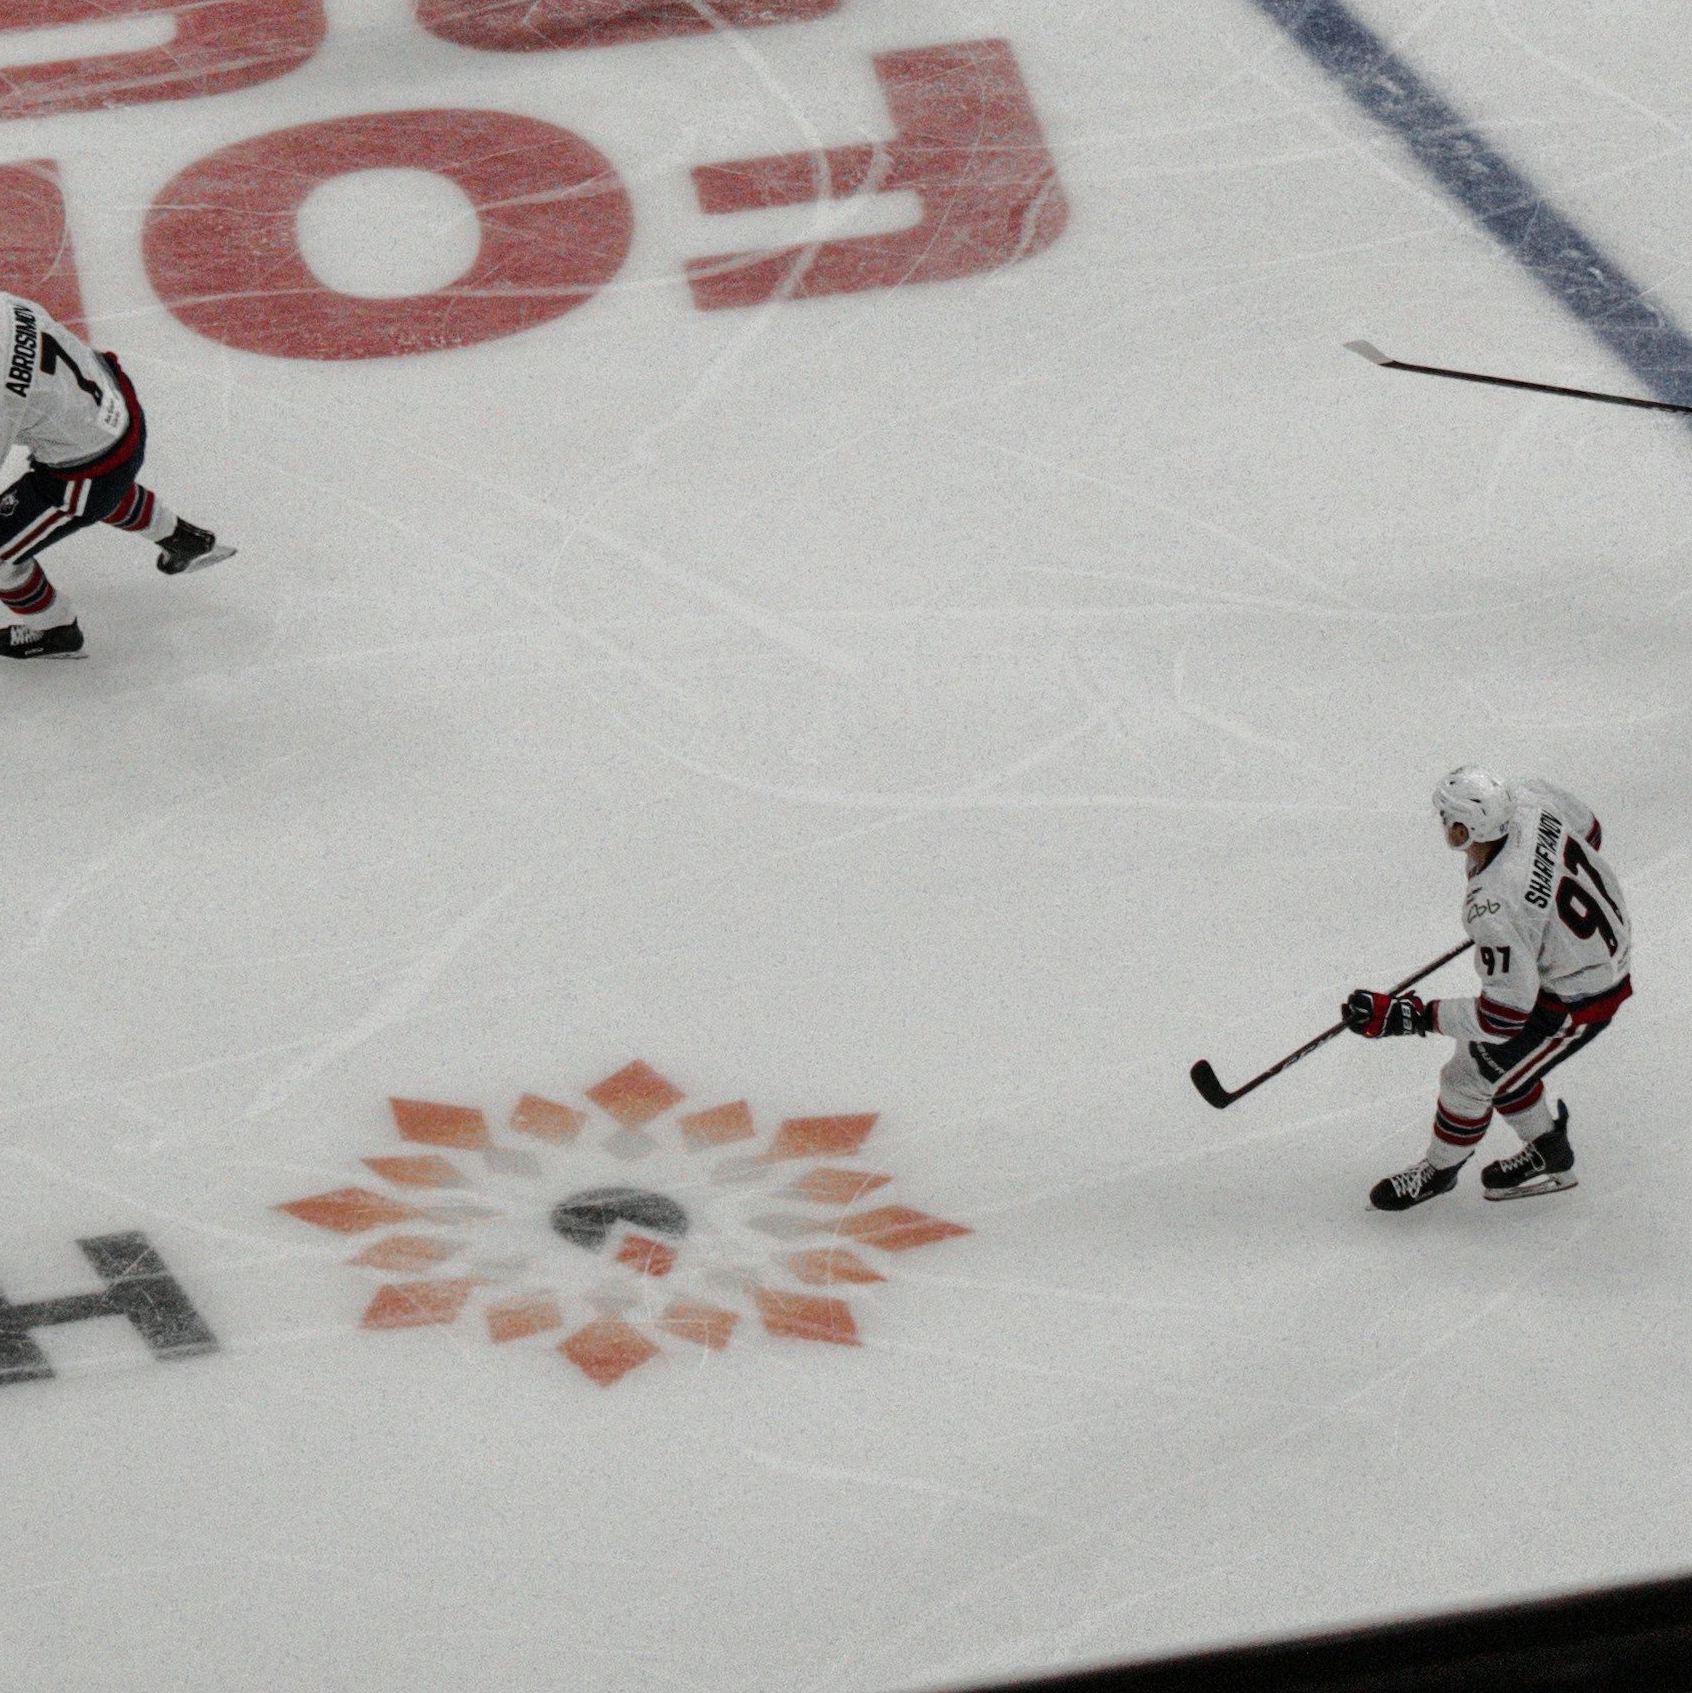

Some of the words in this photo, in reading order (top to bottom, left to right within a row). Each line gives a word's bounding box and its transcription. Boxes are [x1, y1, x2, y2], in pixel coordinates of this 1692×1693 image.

[4, 304, 38, 398] ABROSIMOV
[39, 331, 104, 407] 7
[1555, 834, 1625, 957] 97
[1480, 945, 1511, 976] 97
